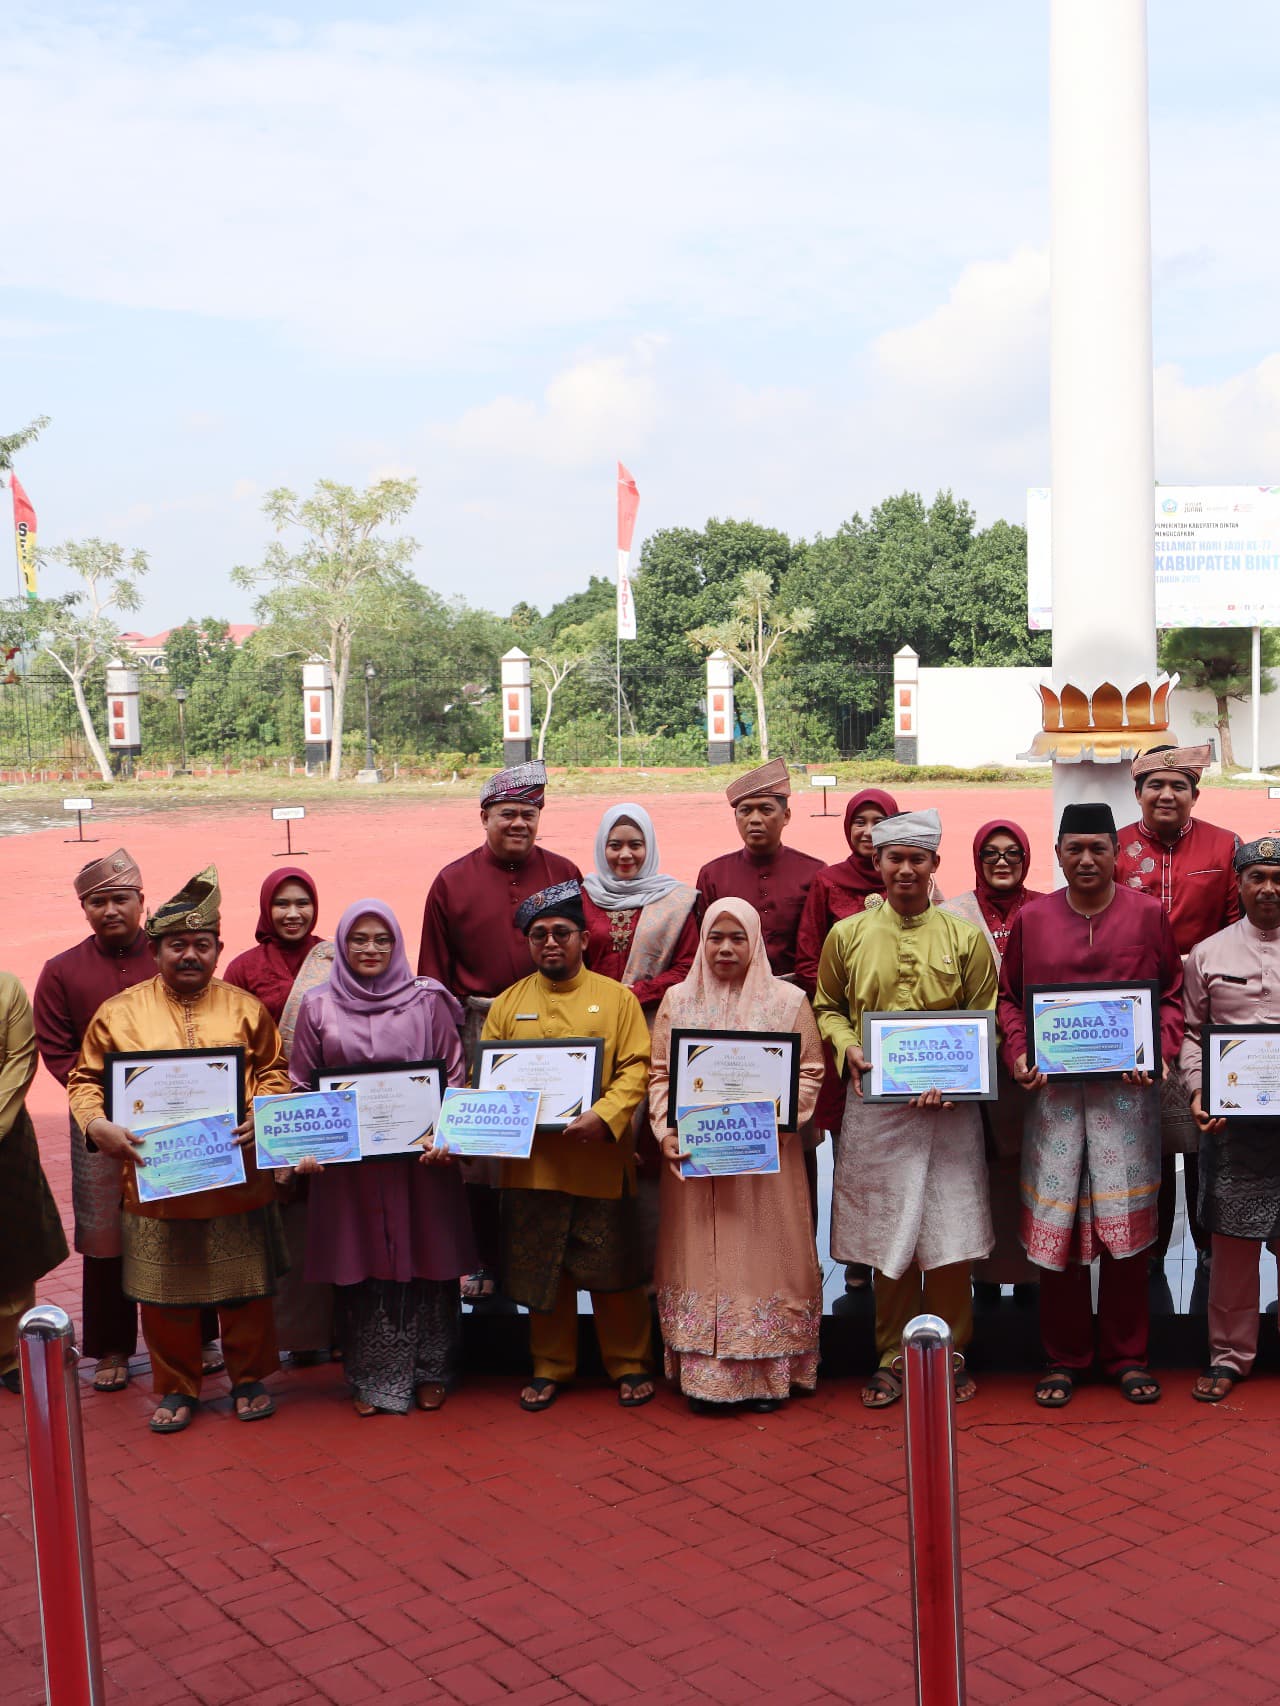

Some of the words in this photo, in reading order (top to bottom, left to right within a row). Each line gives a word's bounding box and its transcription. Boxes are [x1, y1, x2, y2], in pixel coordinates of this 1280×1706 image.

[1155, 541, 1197, 551] SELAMAT
[1199, 541, 1220, 551] HARI
[1155, 555, 1241, 571] KABUPATEN
[1155, 575, 1180, 583] TAHUN
[1052, 1016, 1104, 1029] JUARA
[1108, 1015, 1117, 1026] 3
[1042, 1028, 1129, 1043] Rp2.000.000
[898, 1038, 951, 1051] JUARA
[954, 1038, 963, 1050] 2
[888, 1050, 974, 1065] Rp3.500.000
[274, 1107, 327, 1123] JUARA
[331, 1106, 341, 1117] 2
[458, 1102, 508, 1114] JUARA
[512, 1104, 521, 1114] 3
[263, 1118, 352, 1137] Rp3.500.000
[446, 1114, 529, 1127] Rp2.000.000
[697, 1117, 749, 1132] JUARA
[751, 1117, 757, 1128] 1
[154, 1133, 209, 1153] JUARA
[212, 1131, 219, 1142] 1
[686, 1129, 771, 1146] Rp5.000.000
[143, 1141, 233, 1168] Rp5.000.000
